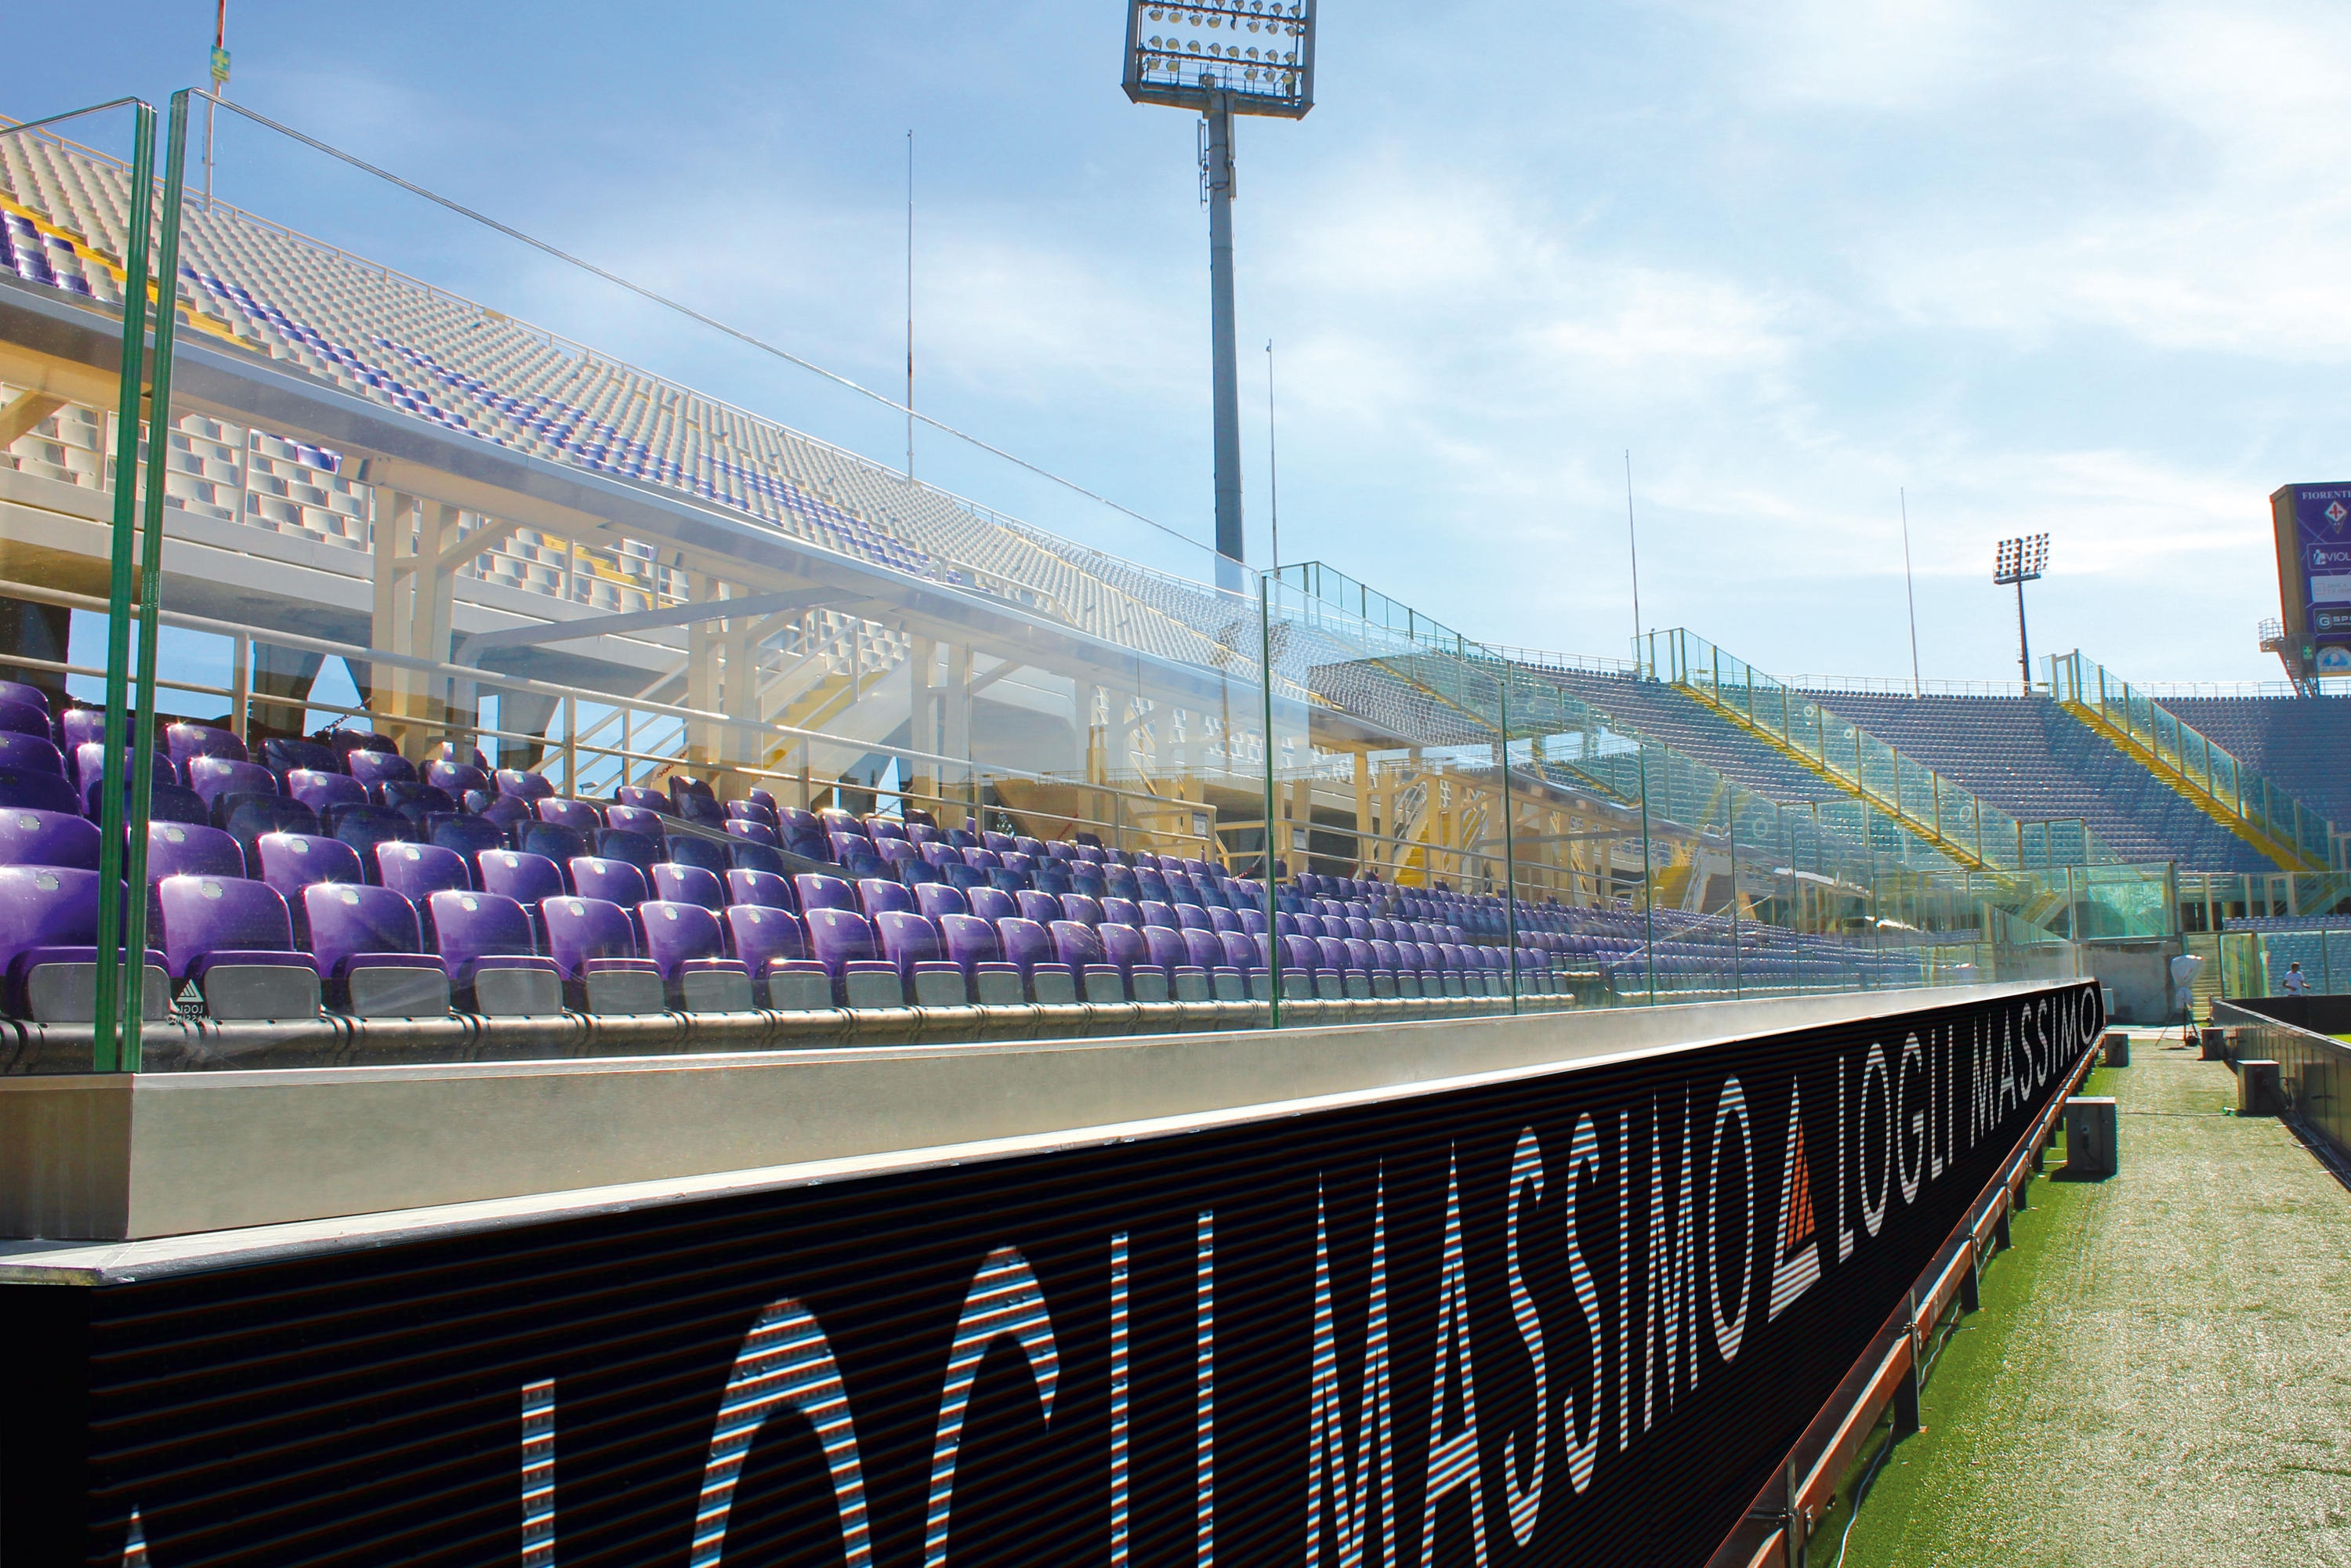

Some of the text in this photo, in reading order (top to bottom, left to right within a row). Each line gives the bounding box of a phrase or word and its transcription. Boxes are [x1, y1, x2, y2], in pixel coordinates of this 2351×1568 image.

[2332, 615, 2351, 624] SP
[1838, 986, 2096, 1264] LOGLI MASSIMO
[1305, 1073, 1754, 1568] MASSIMO
